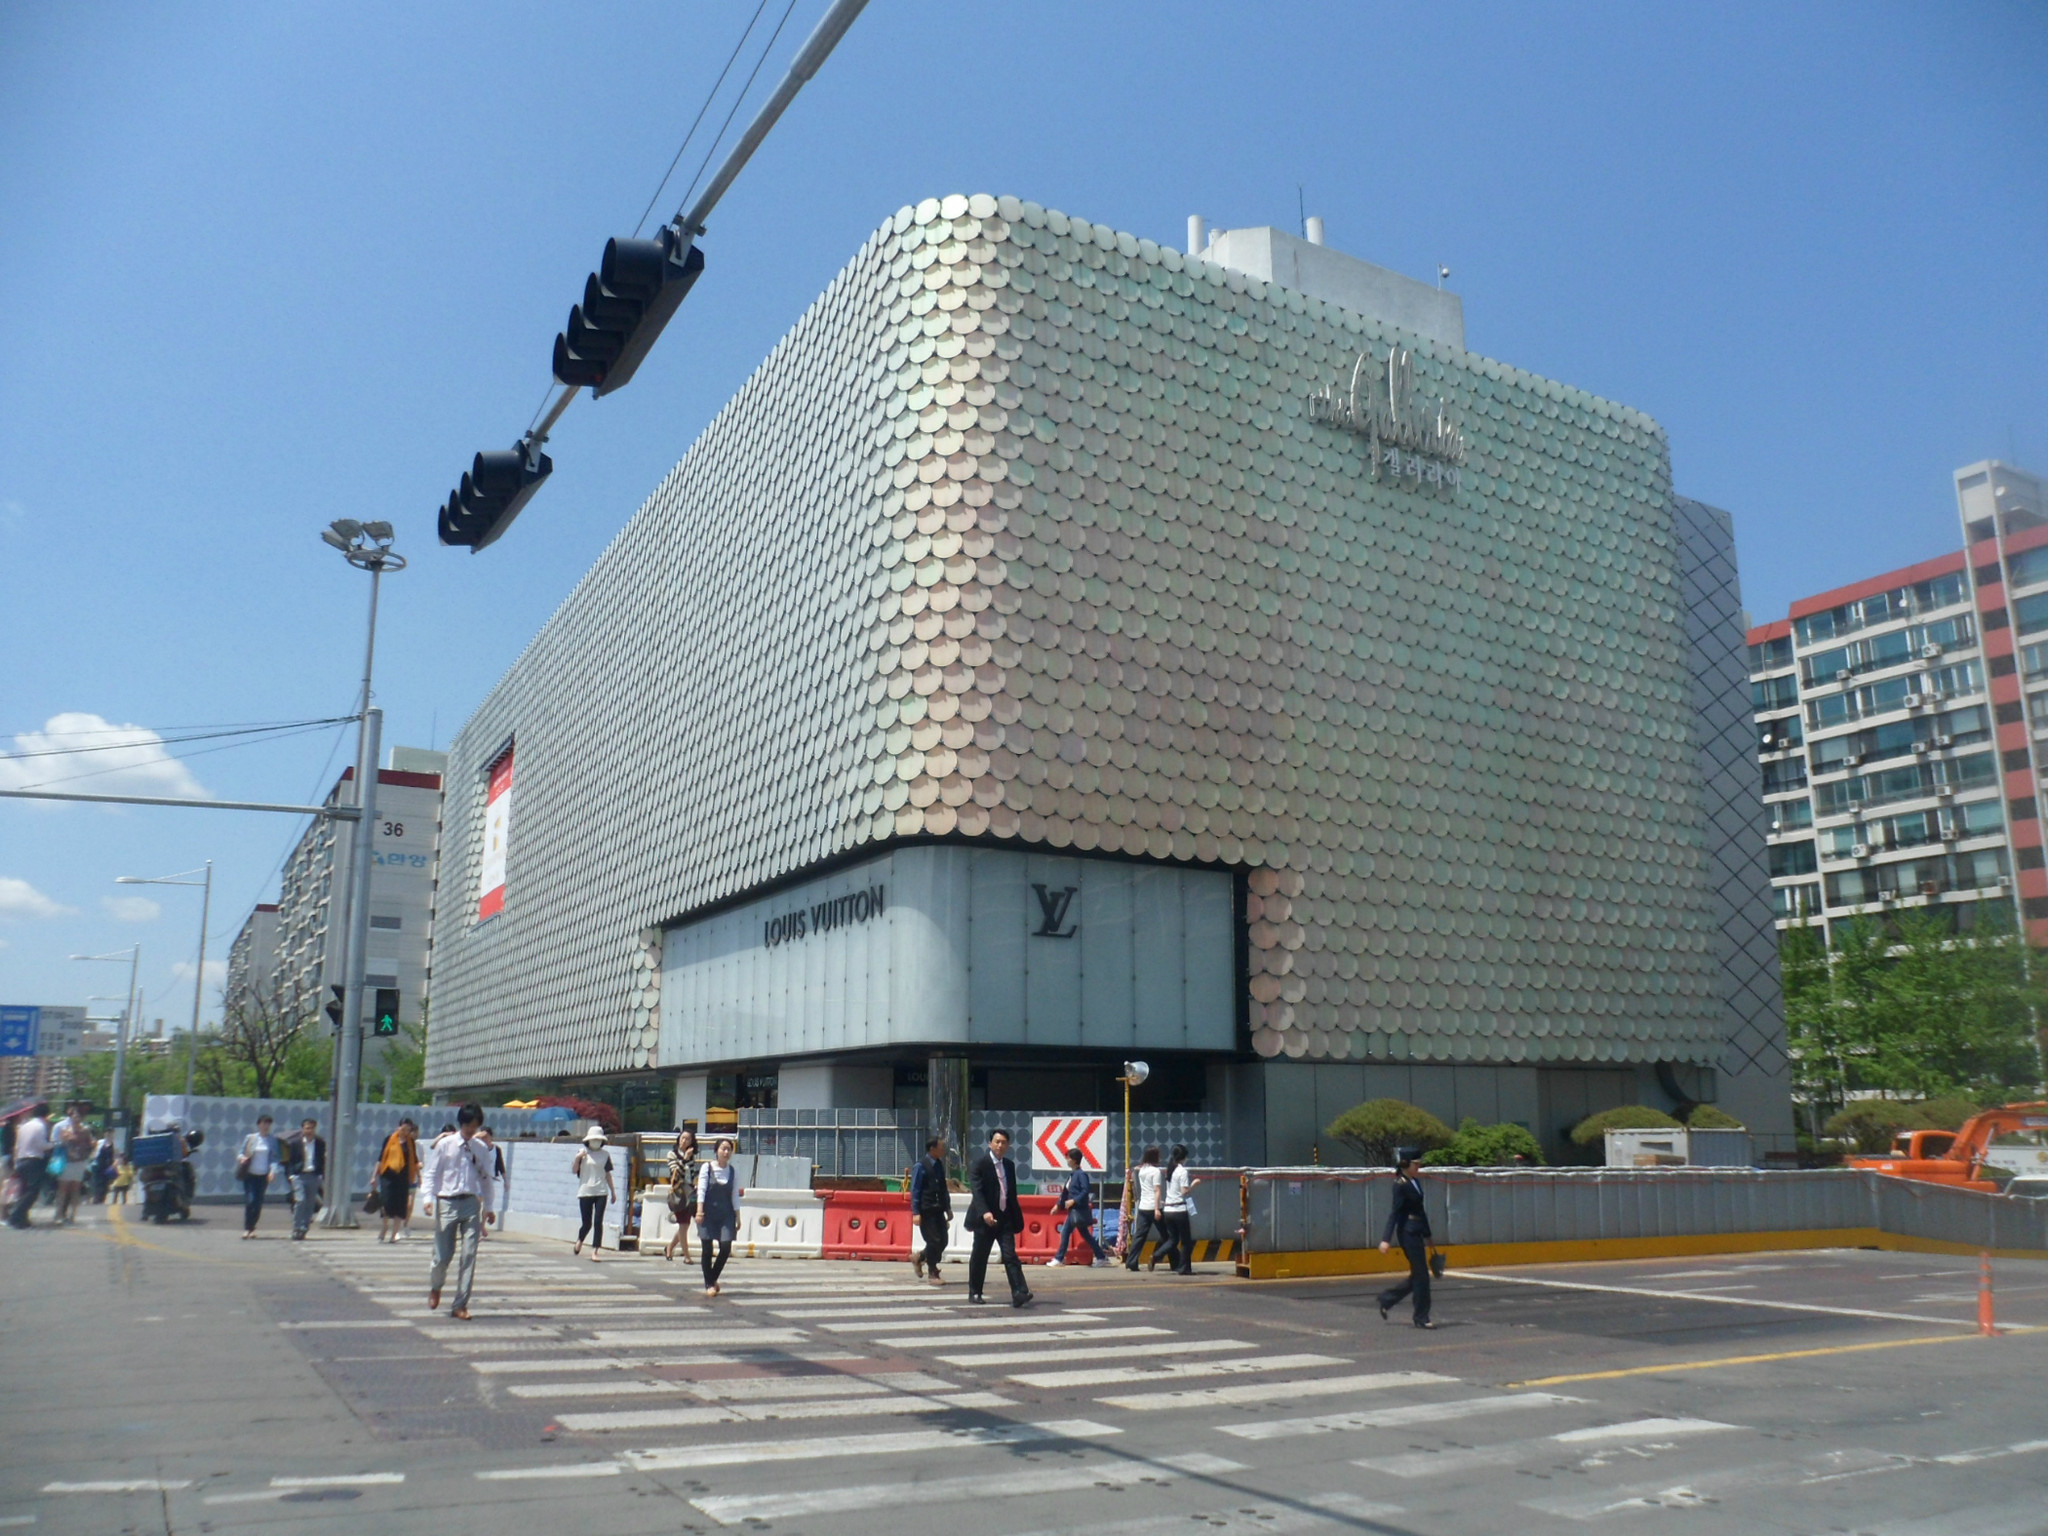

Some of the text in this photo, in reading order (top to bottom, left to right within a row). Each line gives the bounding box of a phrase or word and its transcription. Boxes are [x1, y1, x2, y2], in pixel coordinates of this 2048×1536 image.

[1383, 447, 1462, 495] 갤러리아
[383, 821, 404, 838] 36
[764, 884, 884, 949] LOUIS VUITTON
